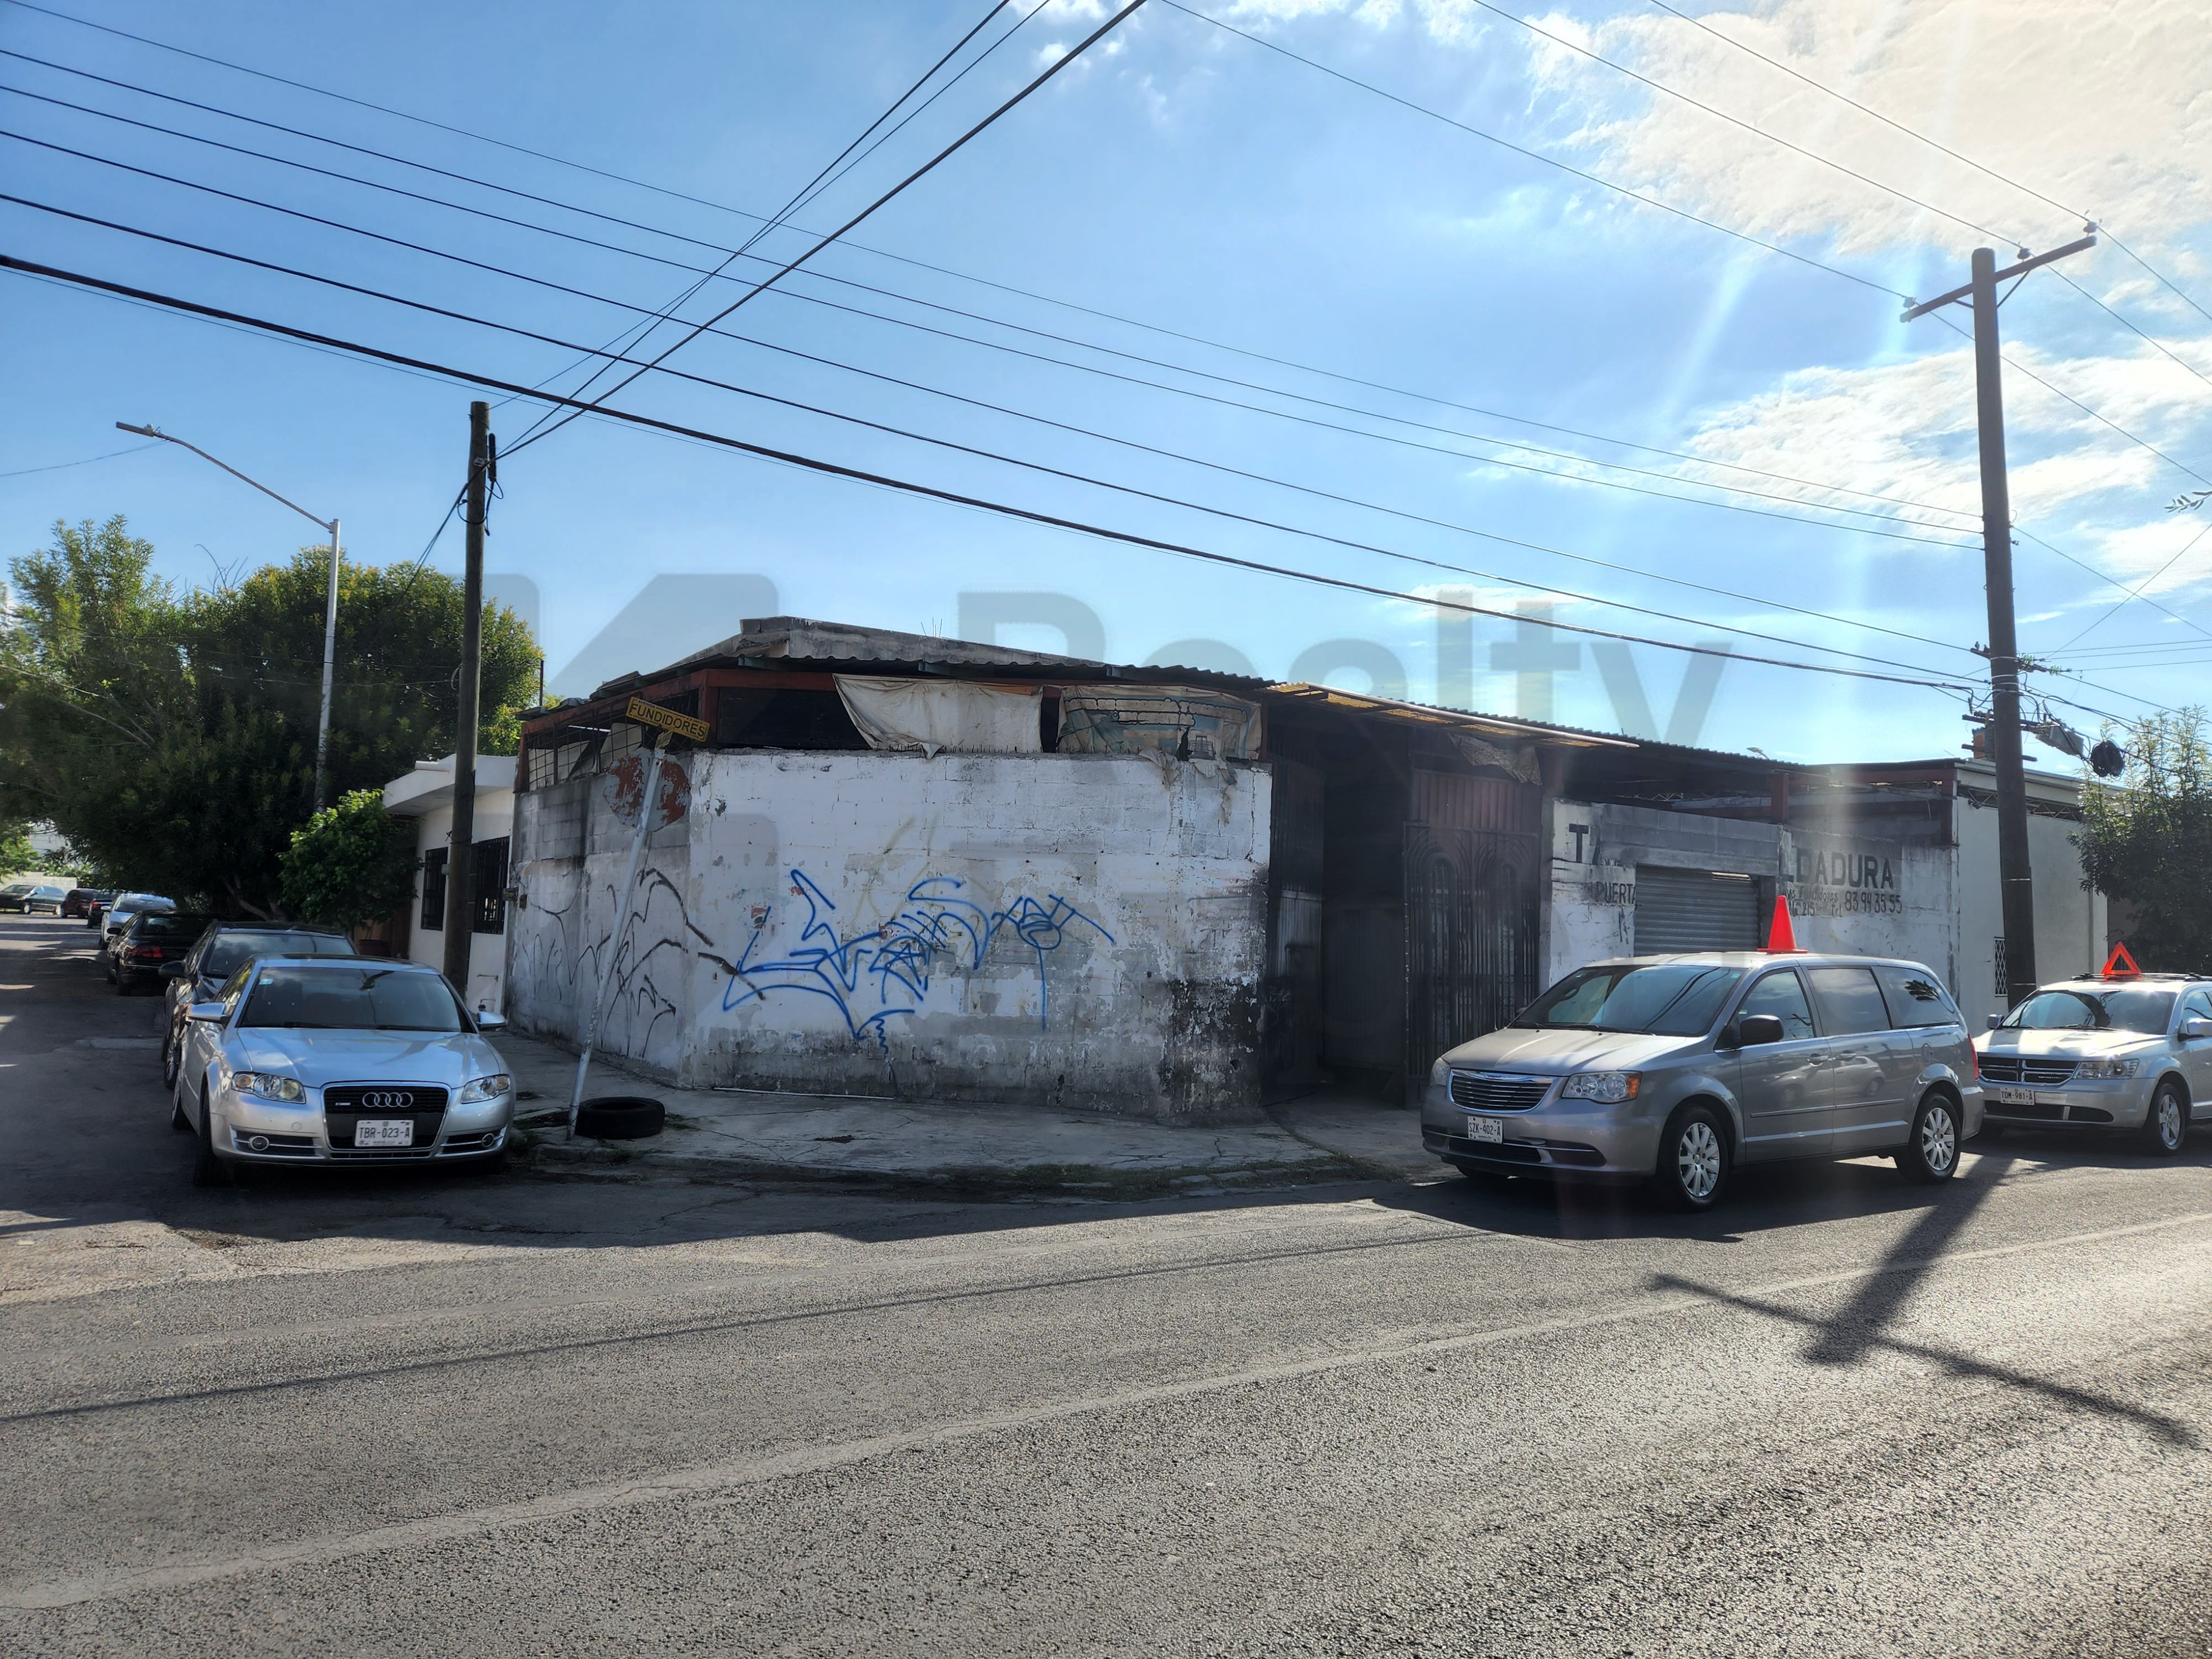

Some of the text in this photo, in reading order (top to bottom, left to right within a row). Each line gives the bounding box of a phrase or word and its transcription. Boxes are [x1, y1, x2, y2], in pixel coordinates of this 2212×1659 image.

[629, 703, 706, 737] FUNDIDORES
[1845, 890, 1859, 912] 83
[1861, 891, 1872, 913] 94
[1874, 893, 1886, 913] 35
[1889, 894, 1902, 914] 55
[359, 1126, 410, 1139] TBR-023-A
[1469, 1122, 1501, 1136] SZK-402-A
